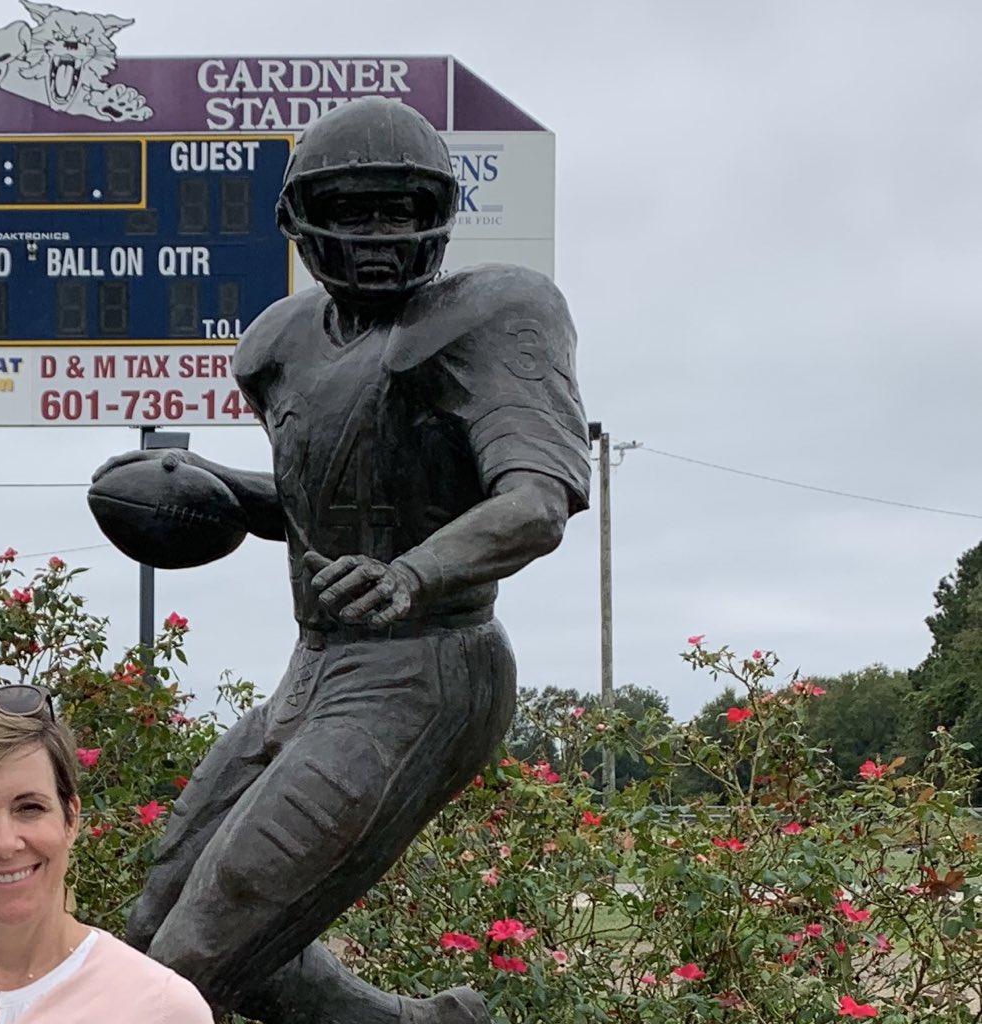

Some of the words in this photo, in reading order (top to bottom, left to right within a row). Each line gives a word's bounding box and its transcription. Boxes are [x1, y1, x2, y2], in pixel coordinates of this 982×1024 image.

[197, 60, 410, 92] GARDNER
[205, 97, 402, 130] STAD
[170, 141, 259, 171] GUEST
[476, 216, 503, 225] FDIC
[47, 247, 104, 276] BALL
[110, 247, 143, 276] ON
[158, 246, 210, 276] QTR
[202, 319, 244, 339] T.O.L
[41, 355, 57, 378] D
[66, 355, 85, 379] &
[93, 355, 116, 378] M
[124, 355, 170, 378] TAX
